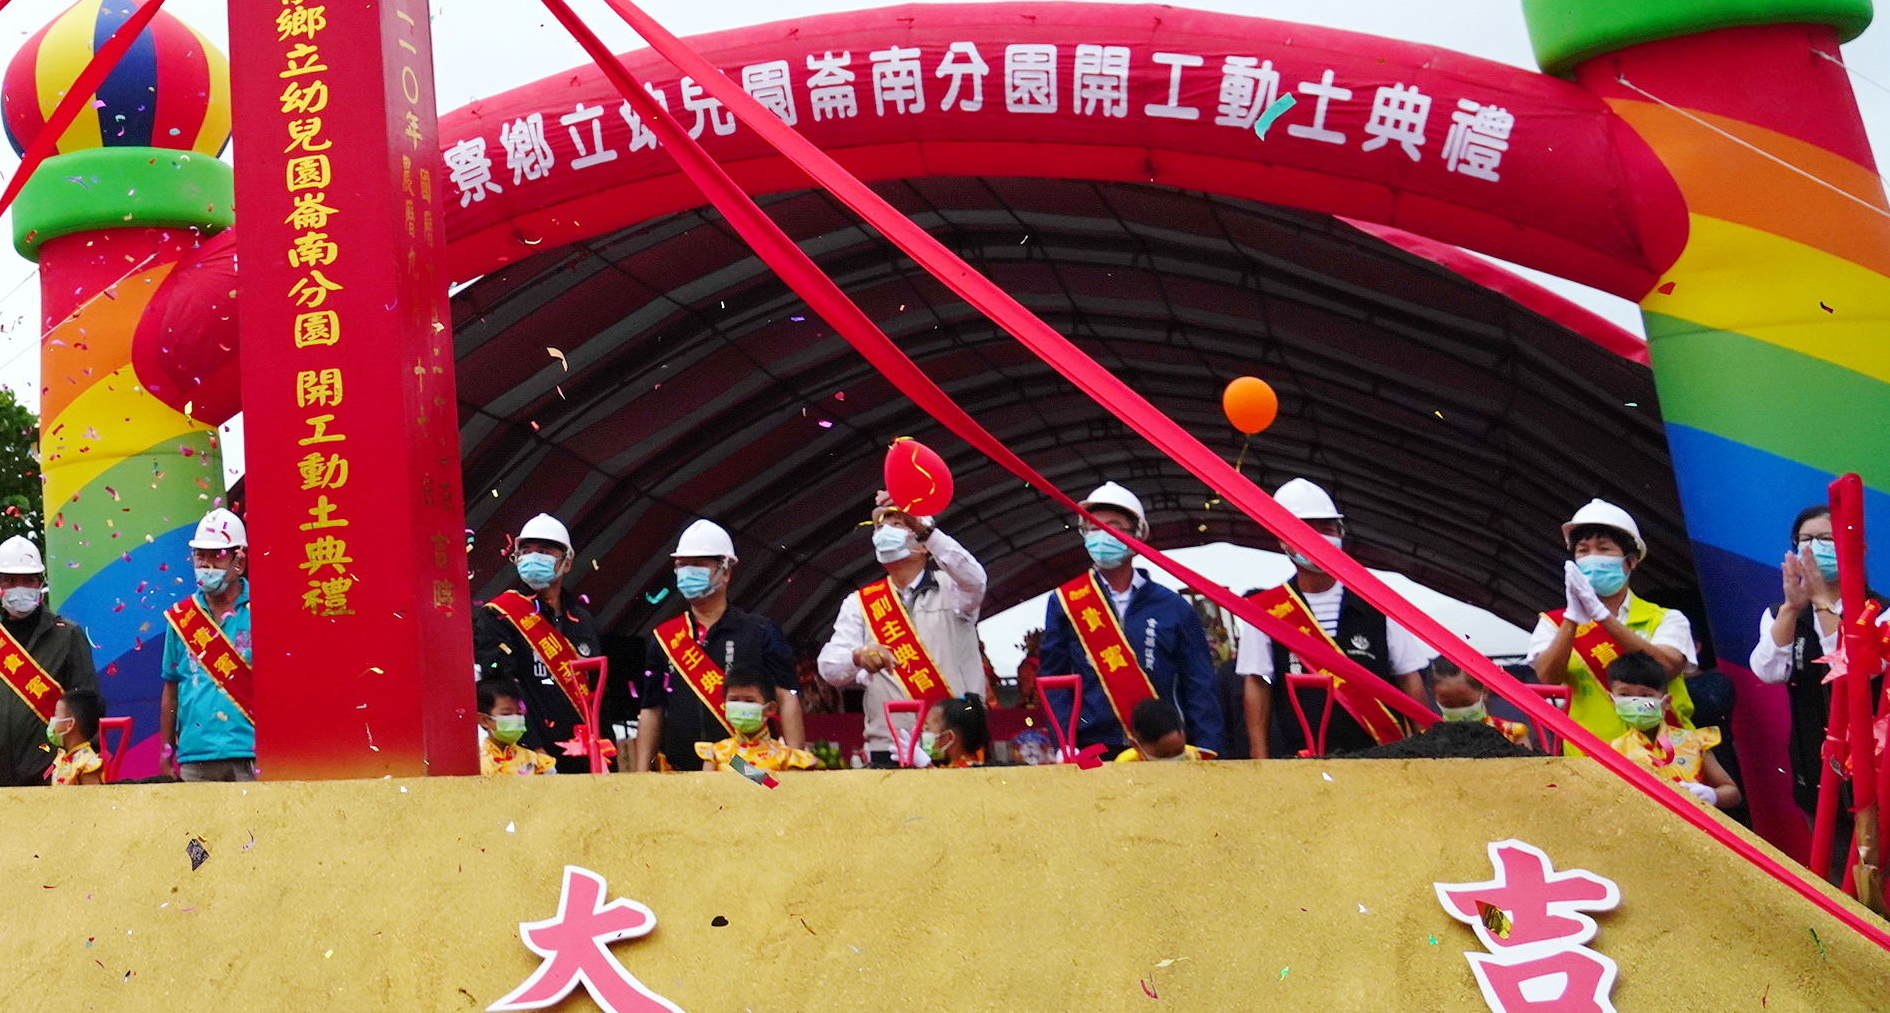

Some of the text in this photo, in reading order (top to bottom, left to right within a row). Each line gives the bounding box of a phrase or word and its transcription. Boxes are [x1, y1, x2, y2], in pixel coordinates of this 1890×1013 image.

[297, 369, 355, 616] 開工動土典禮
[192, 626, 238, 678] 貴賓
[869, 594, 935, 693] 副主典官
[1081, 606, 1128, 672] 貴賓
[3, 653, 50, 699] 貴賓
[681, 646, 726, 710] 主典
[486, 864, 684, 1013] 大
[1434, 838, 1622, 1013] 吉
